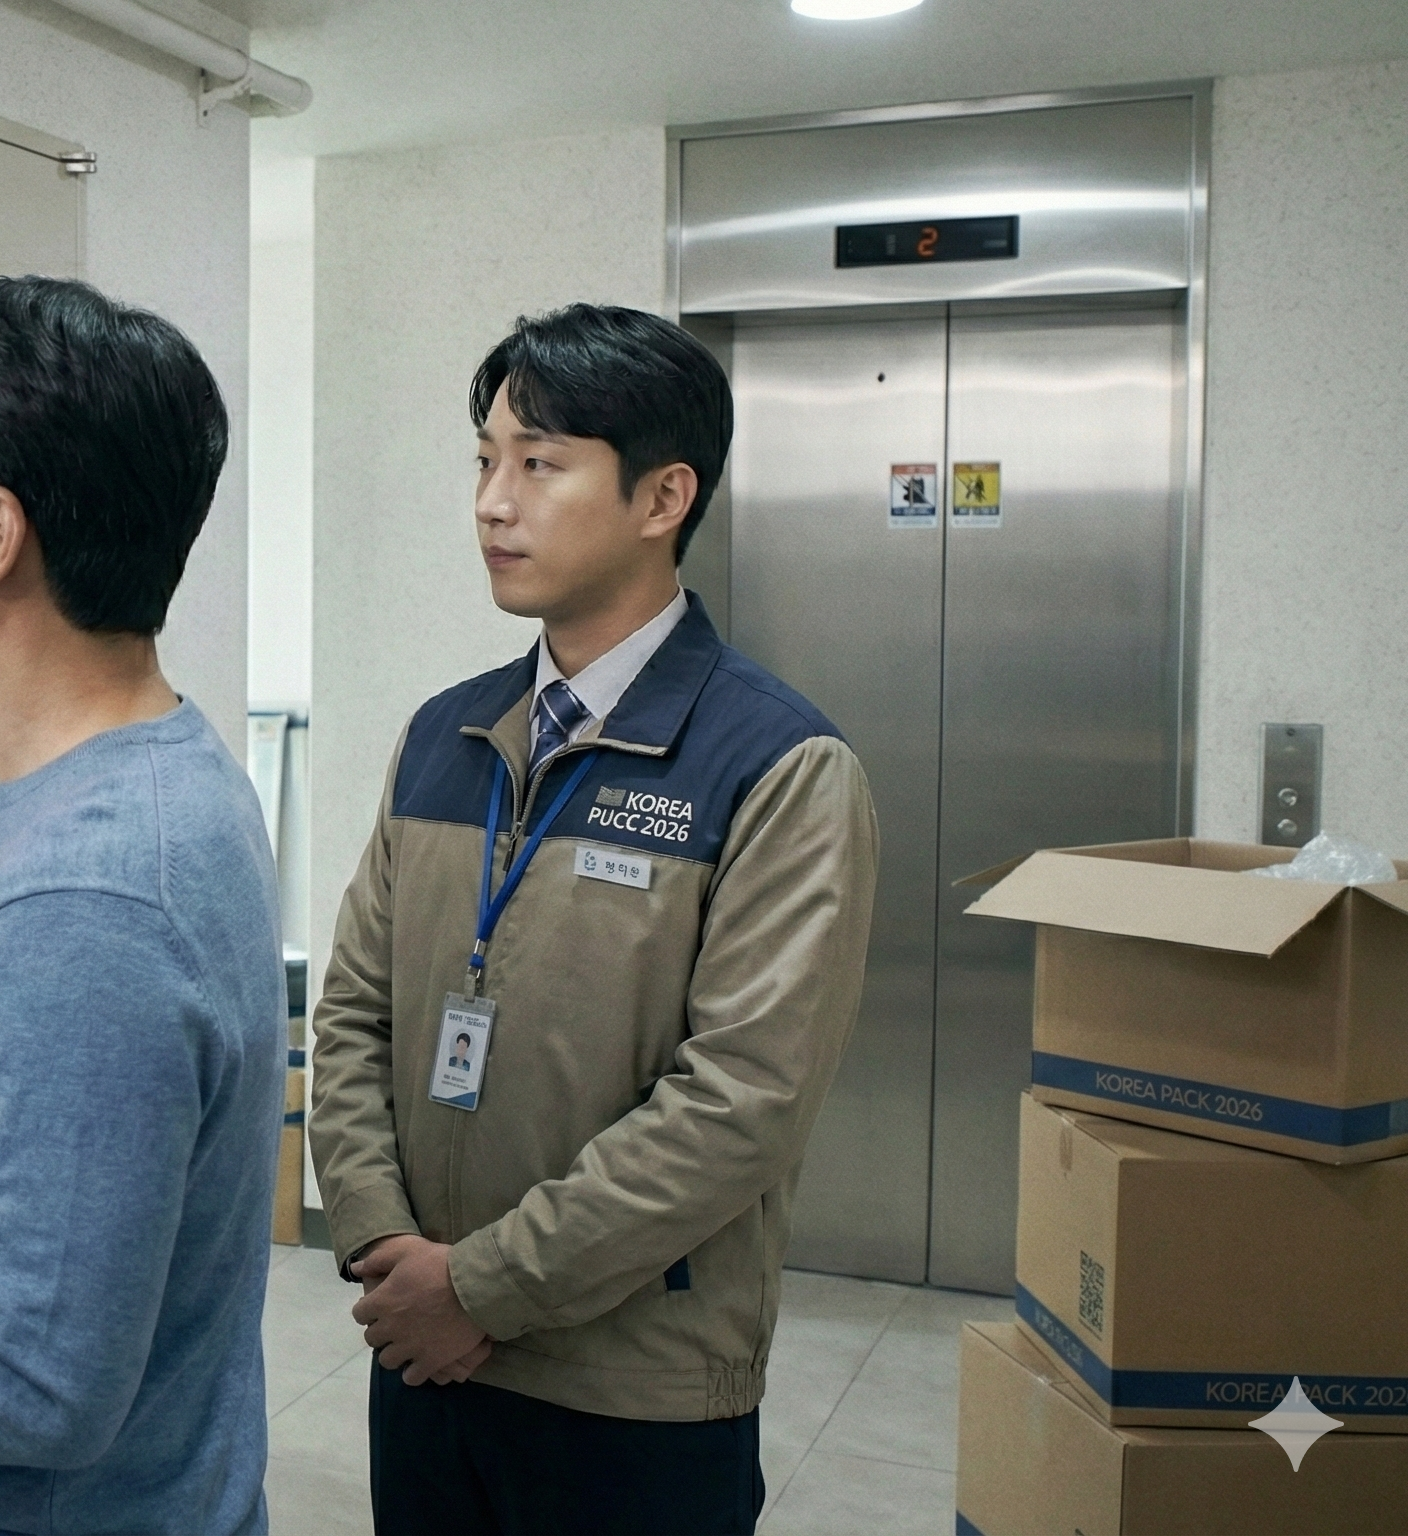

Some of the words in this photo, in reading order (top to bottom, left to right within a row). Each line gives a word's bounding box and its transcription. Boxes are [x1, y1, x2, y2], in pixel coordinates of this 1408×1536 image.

[916, 225, 939, 259] 2
[625, 791, 692, 821] KOREA
[587, 806, 641, 832] PUCC
[640, 816, 691, 842] 2026
[1096, 1071, 1157, 1100] KOREA
[1161, 1084, 1211, 1112] PACK
[1214, 1094, 1263, 1122] 2026
[1206, 1381, 1288, 1404] KOREA
[1295, 1384, 1357, 1406] PACK
[1364, 1386, 1408, 1407] 202
